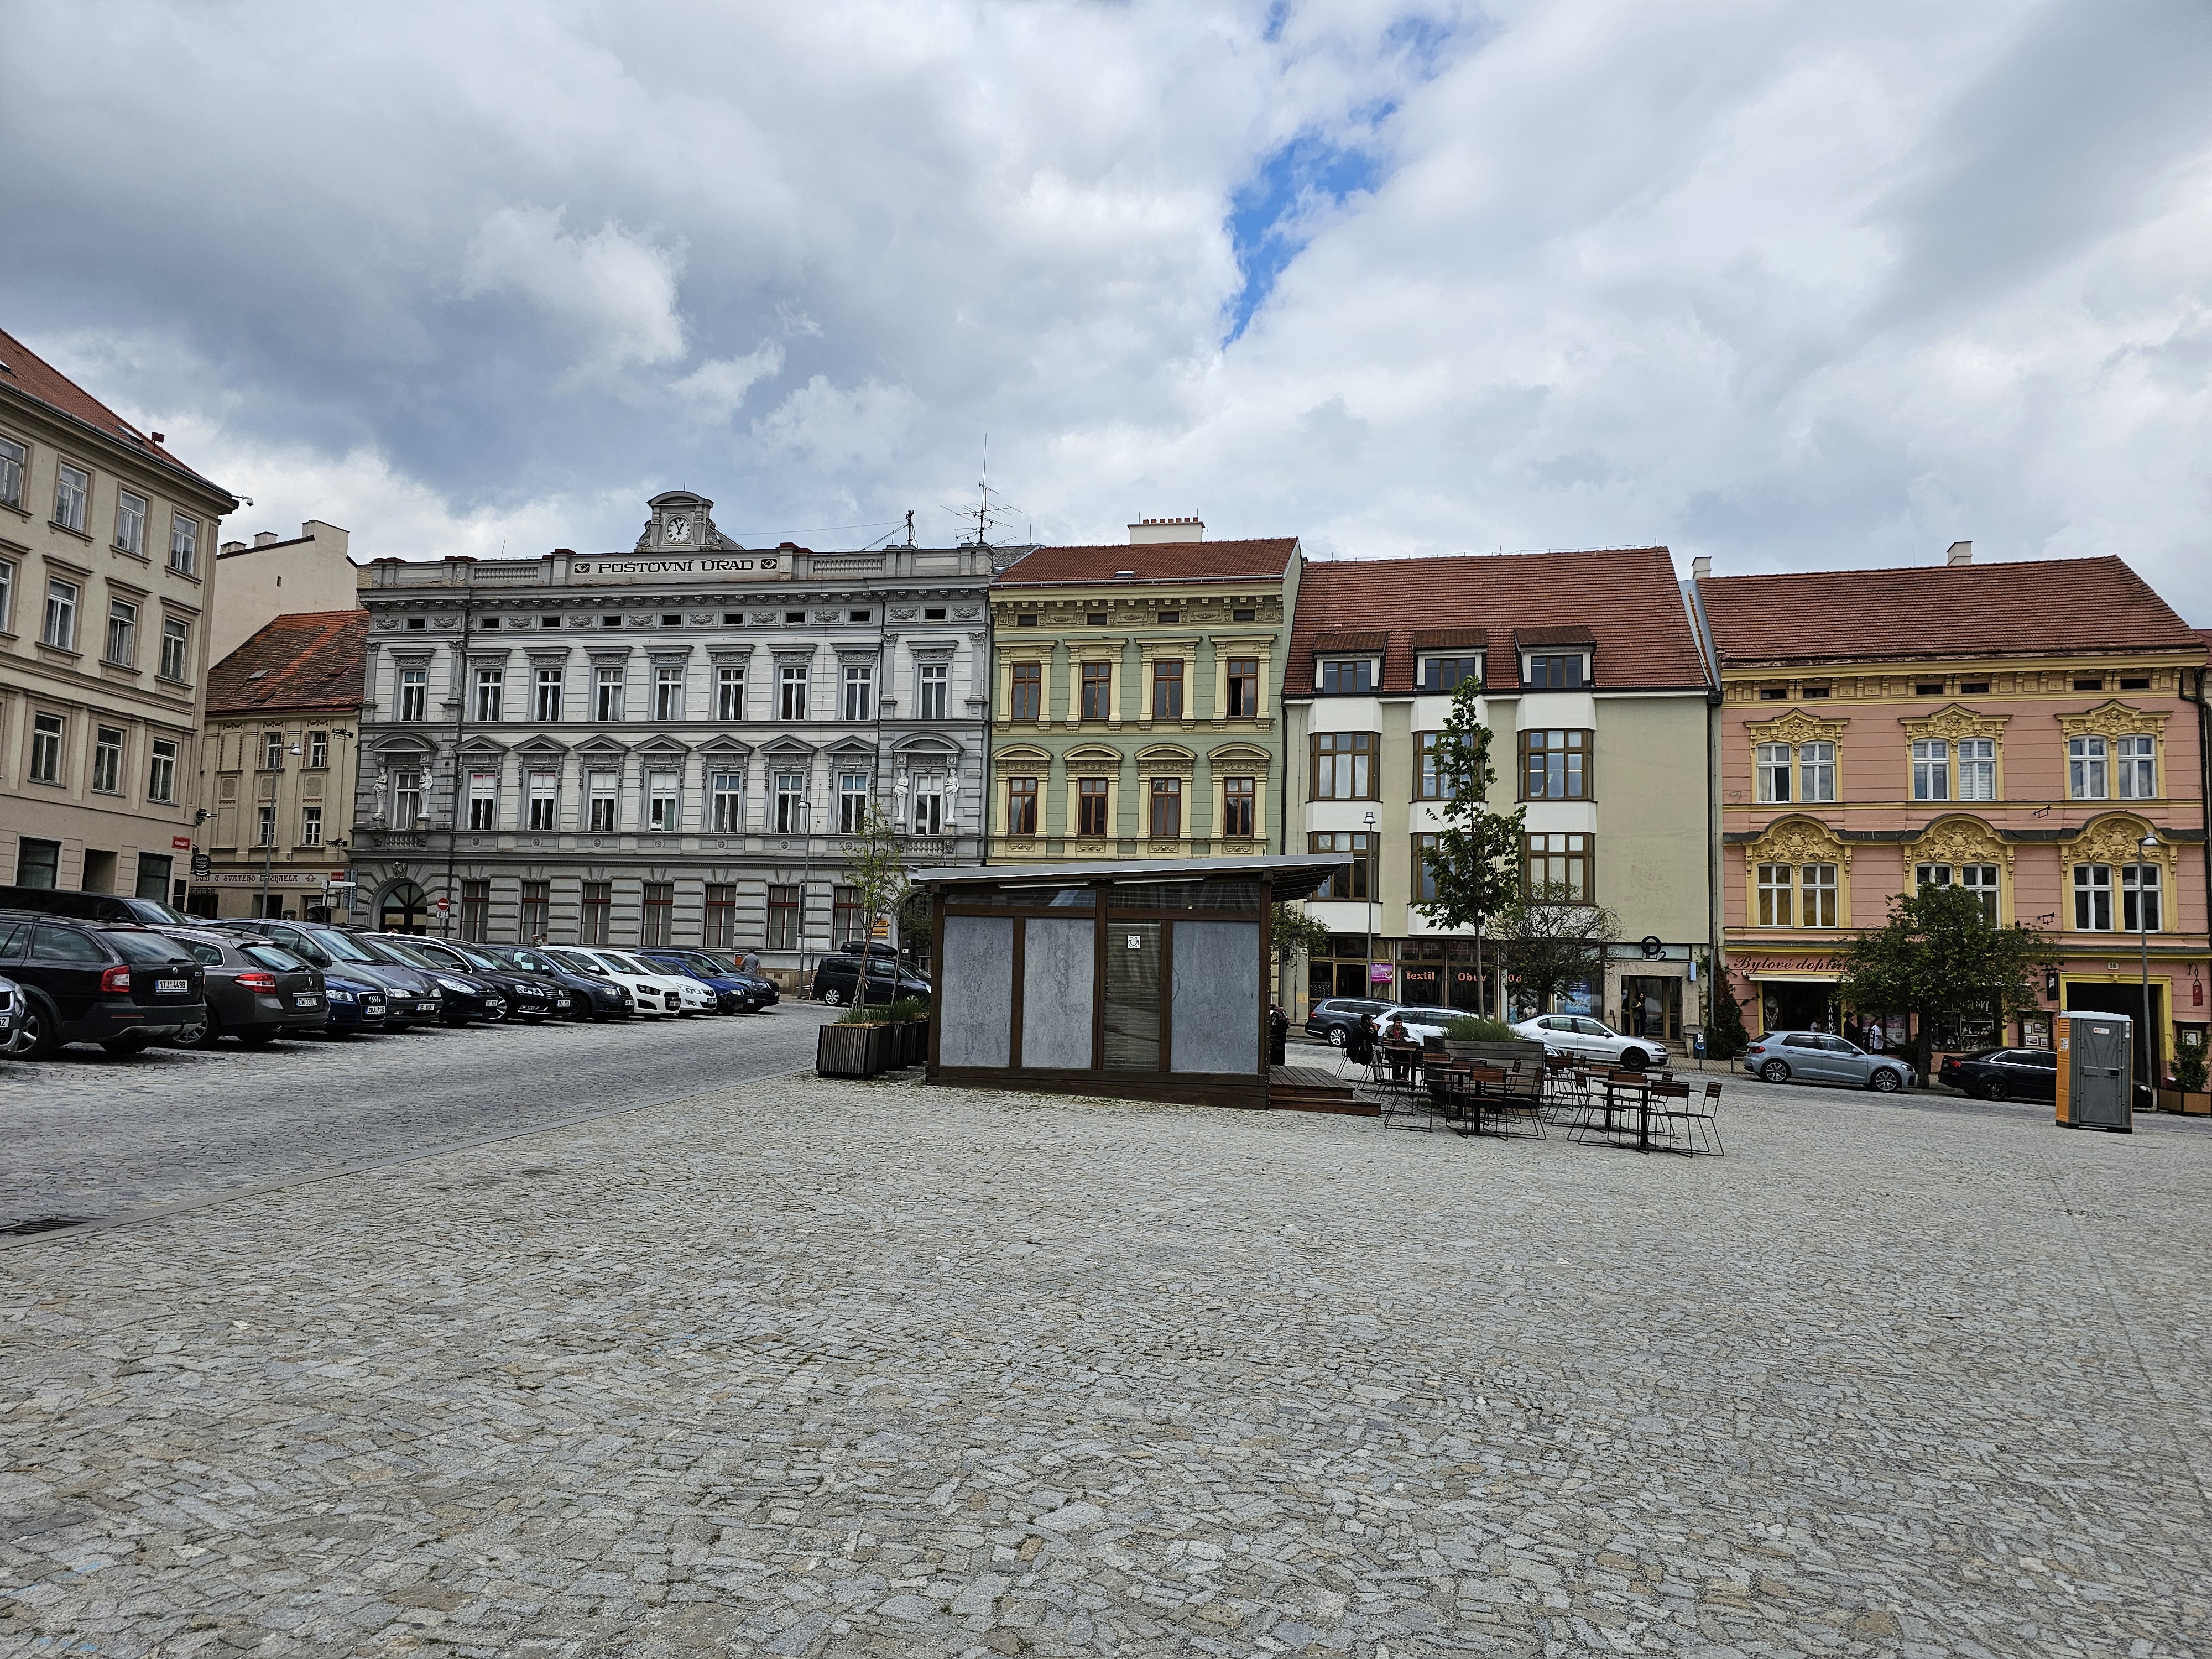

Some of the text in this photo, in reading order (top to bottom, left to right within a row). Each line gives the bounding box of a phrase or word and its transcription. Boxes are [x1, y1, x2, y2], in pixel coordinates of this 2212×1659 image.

[598, 559, 754, 573] POŠTOVNÍ ÚŘAD
[1641, 935, 1667, 960] O2
[1734, 956, 1794, 973] Bytové
[1405, 971, 1435, 980] Textil
[160, 980, 186, 989] 1TJ 4498
